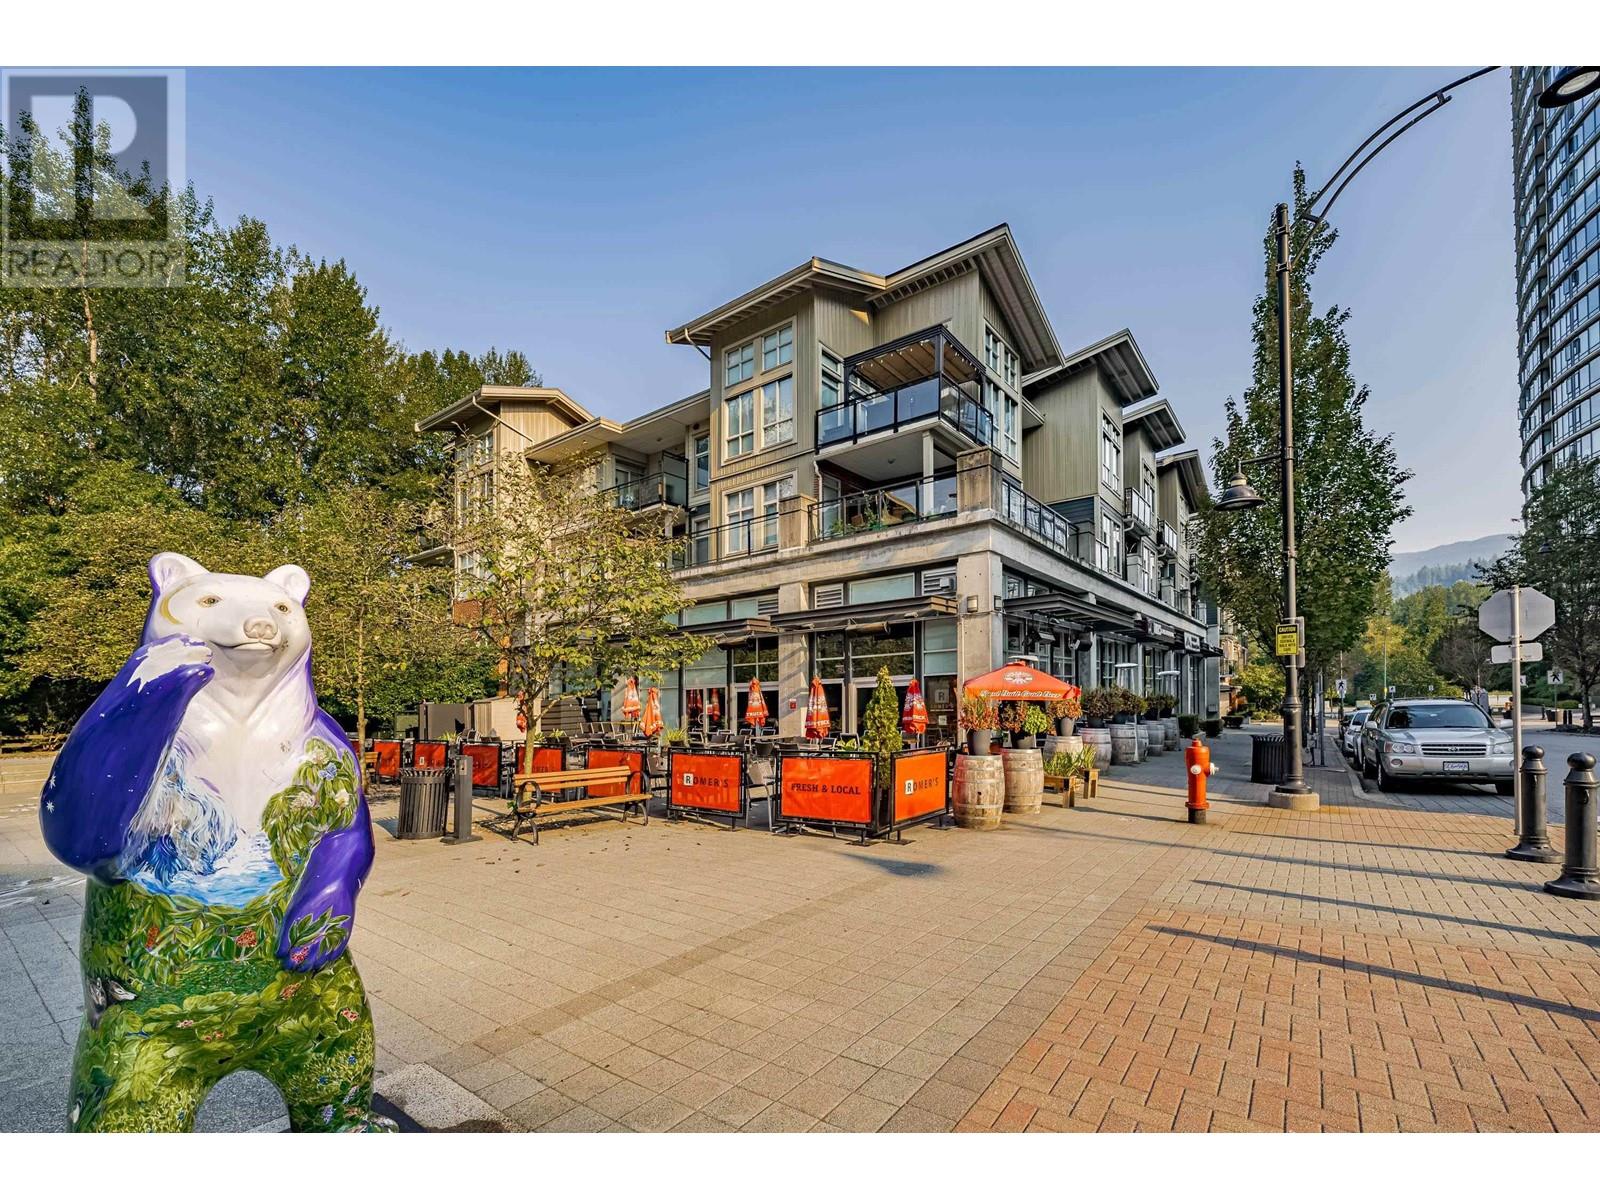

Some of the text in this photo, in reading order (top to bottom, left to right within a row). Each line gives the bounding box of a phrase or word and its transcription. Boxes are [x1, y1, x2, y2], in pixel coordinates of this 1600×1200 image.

[791, 782, 861, 795] FRESH & LOCAL
